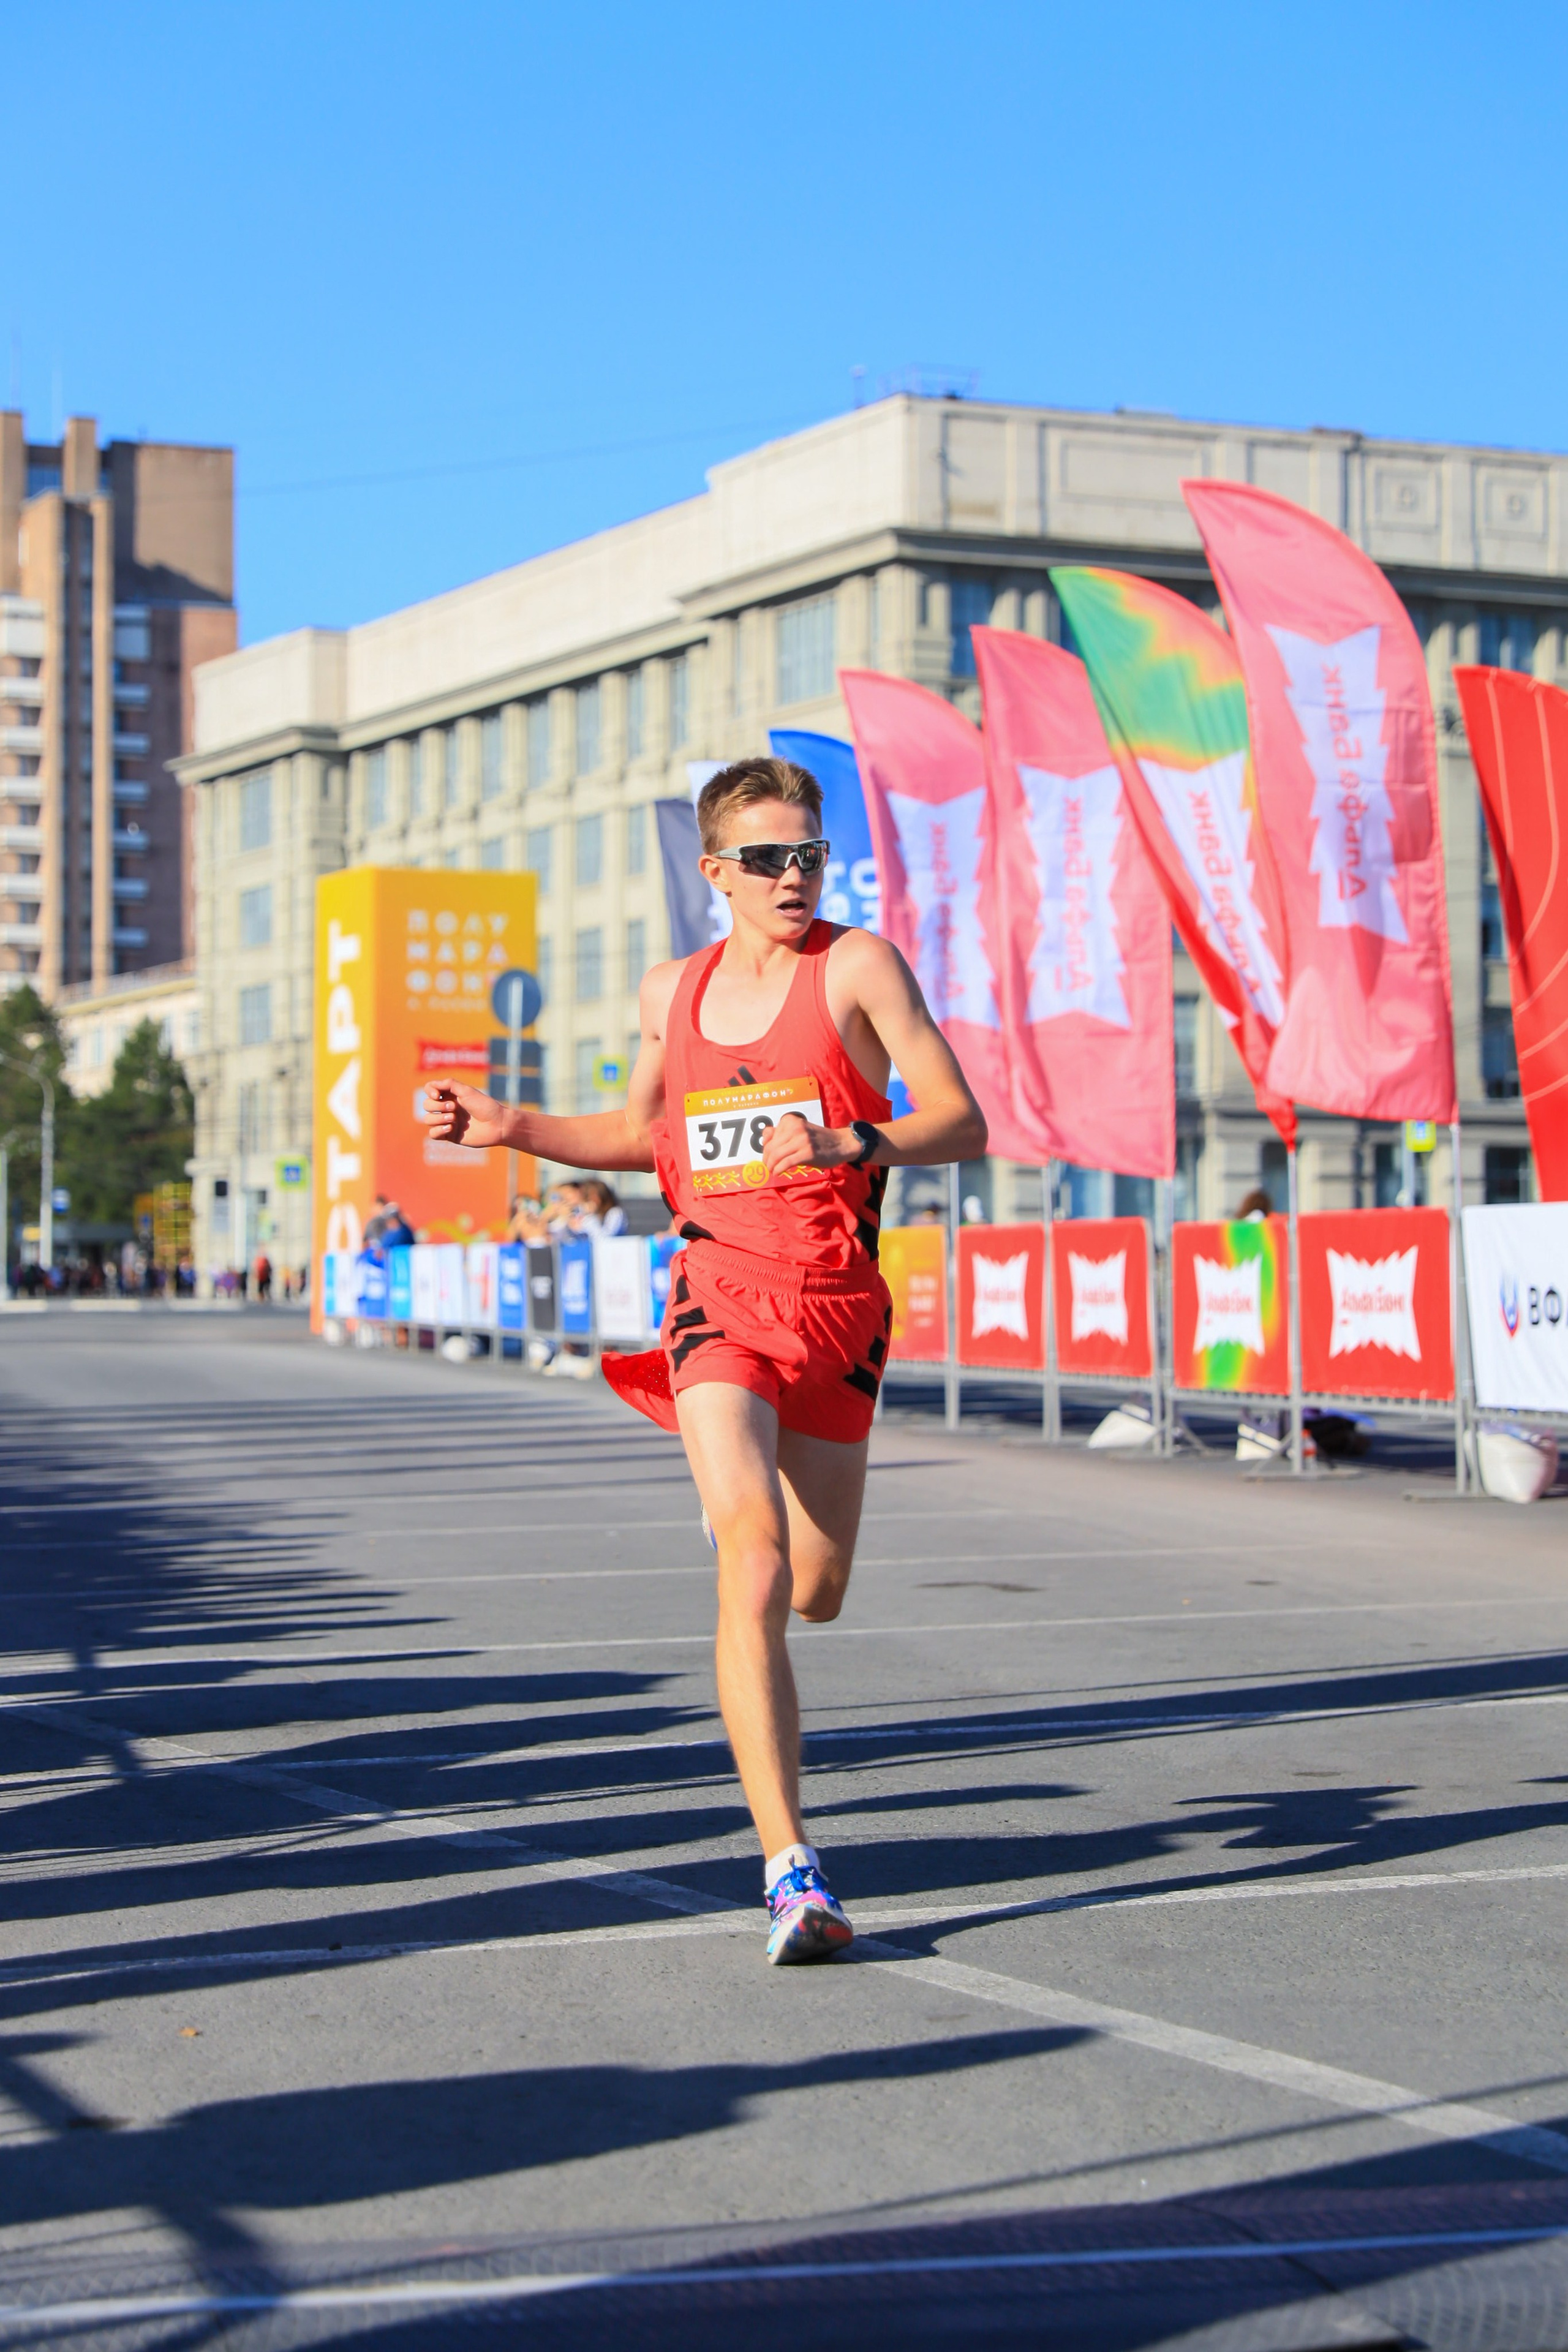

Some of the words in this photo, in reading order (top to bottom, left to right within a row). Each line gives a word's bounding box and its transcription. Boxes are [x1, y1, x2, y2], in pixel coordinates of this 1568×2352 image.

[327, 918, 363, 1253] СТАРТ
[703, 1089, 786, 1106] ПОЛУМАРАФОН
[698, 1111, 807, 1161] 378
[1529, 1283, 1568, 1329] ВФ
